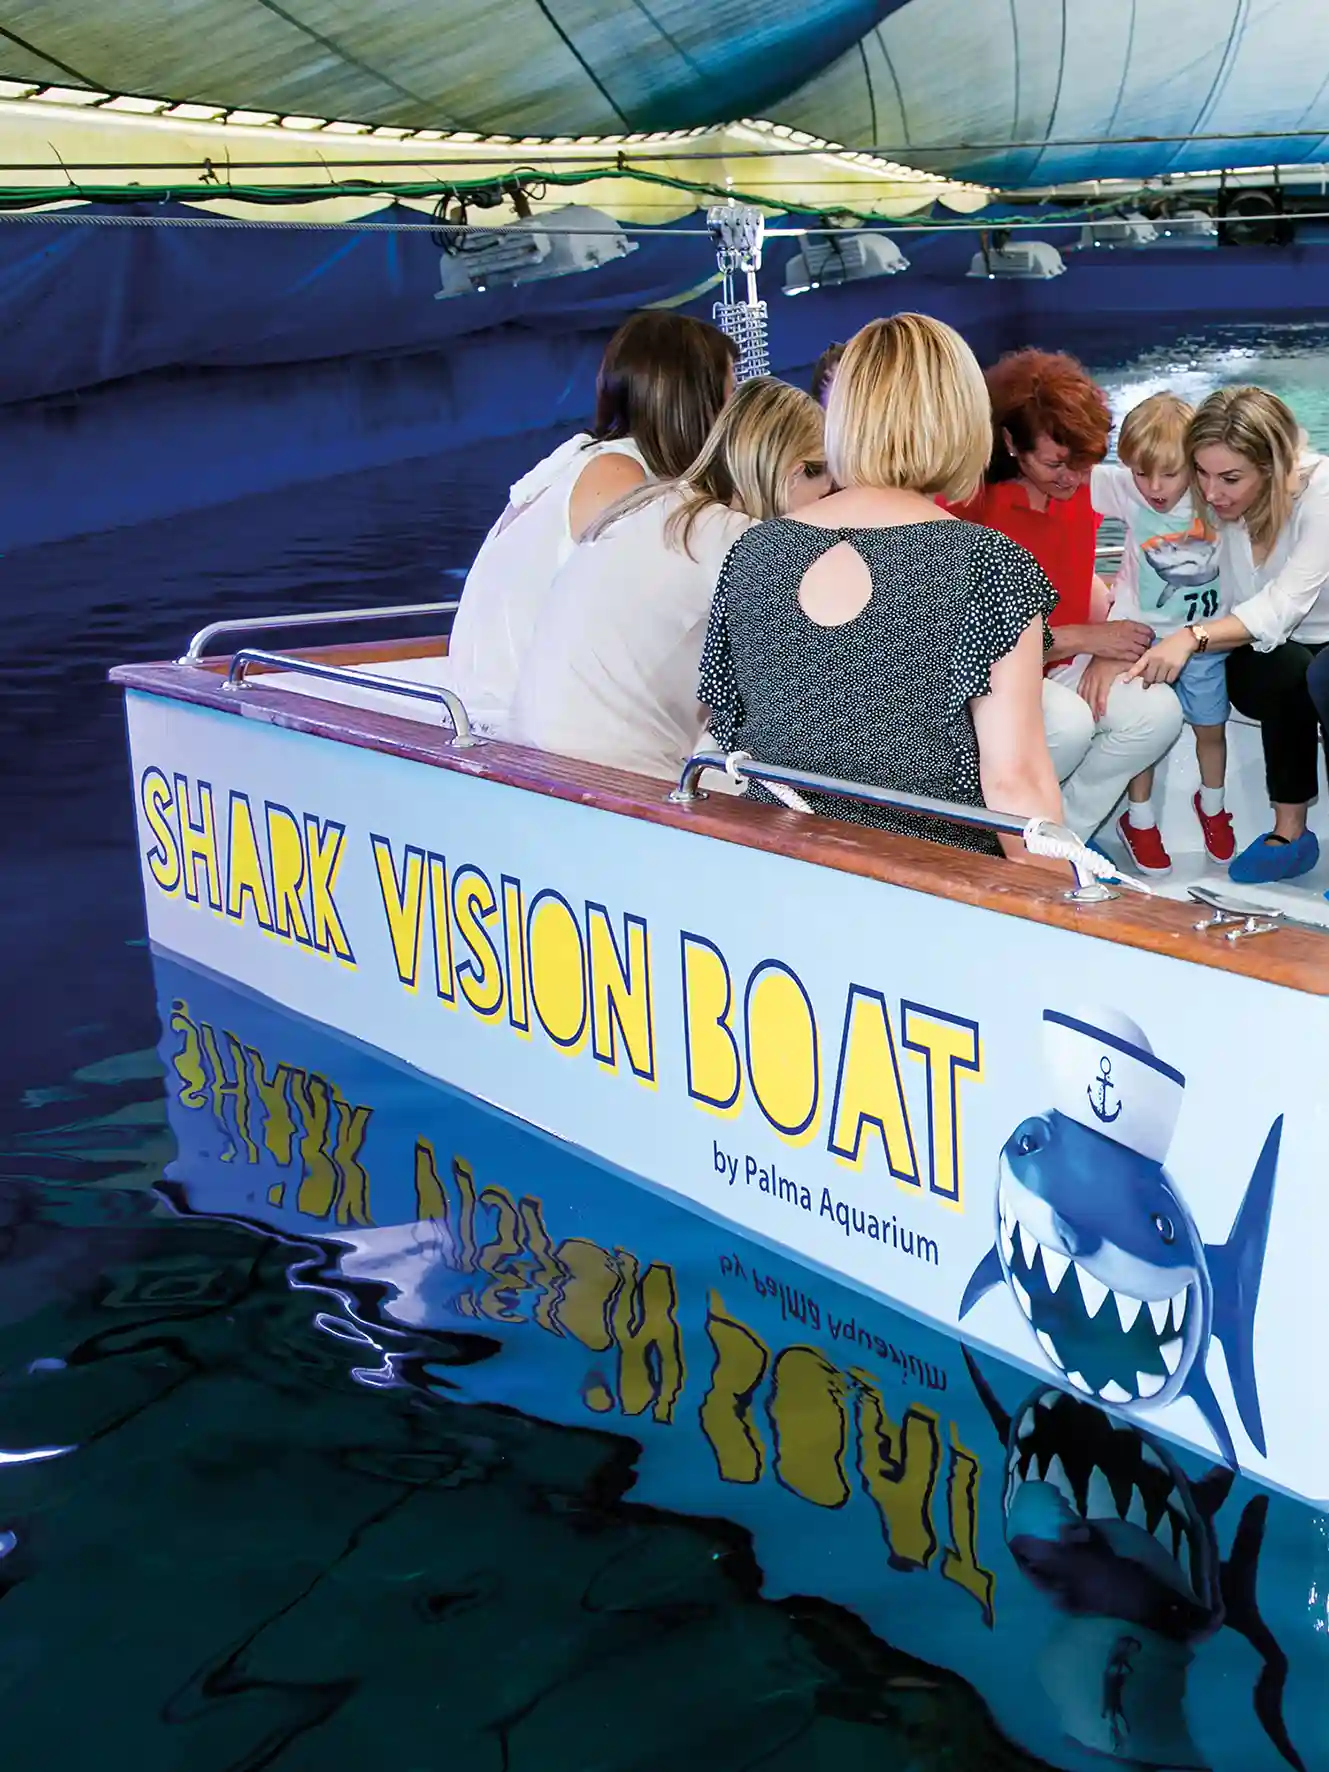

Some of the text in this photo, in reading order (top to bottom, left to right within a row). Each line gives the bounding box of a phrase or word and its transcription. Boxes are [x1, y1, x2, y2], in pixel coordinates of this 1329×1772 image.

[142, 766, 983, 1210] SHARK VISION BOAT
[713, 1140, 939, 1265] by Palma Aquarium
